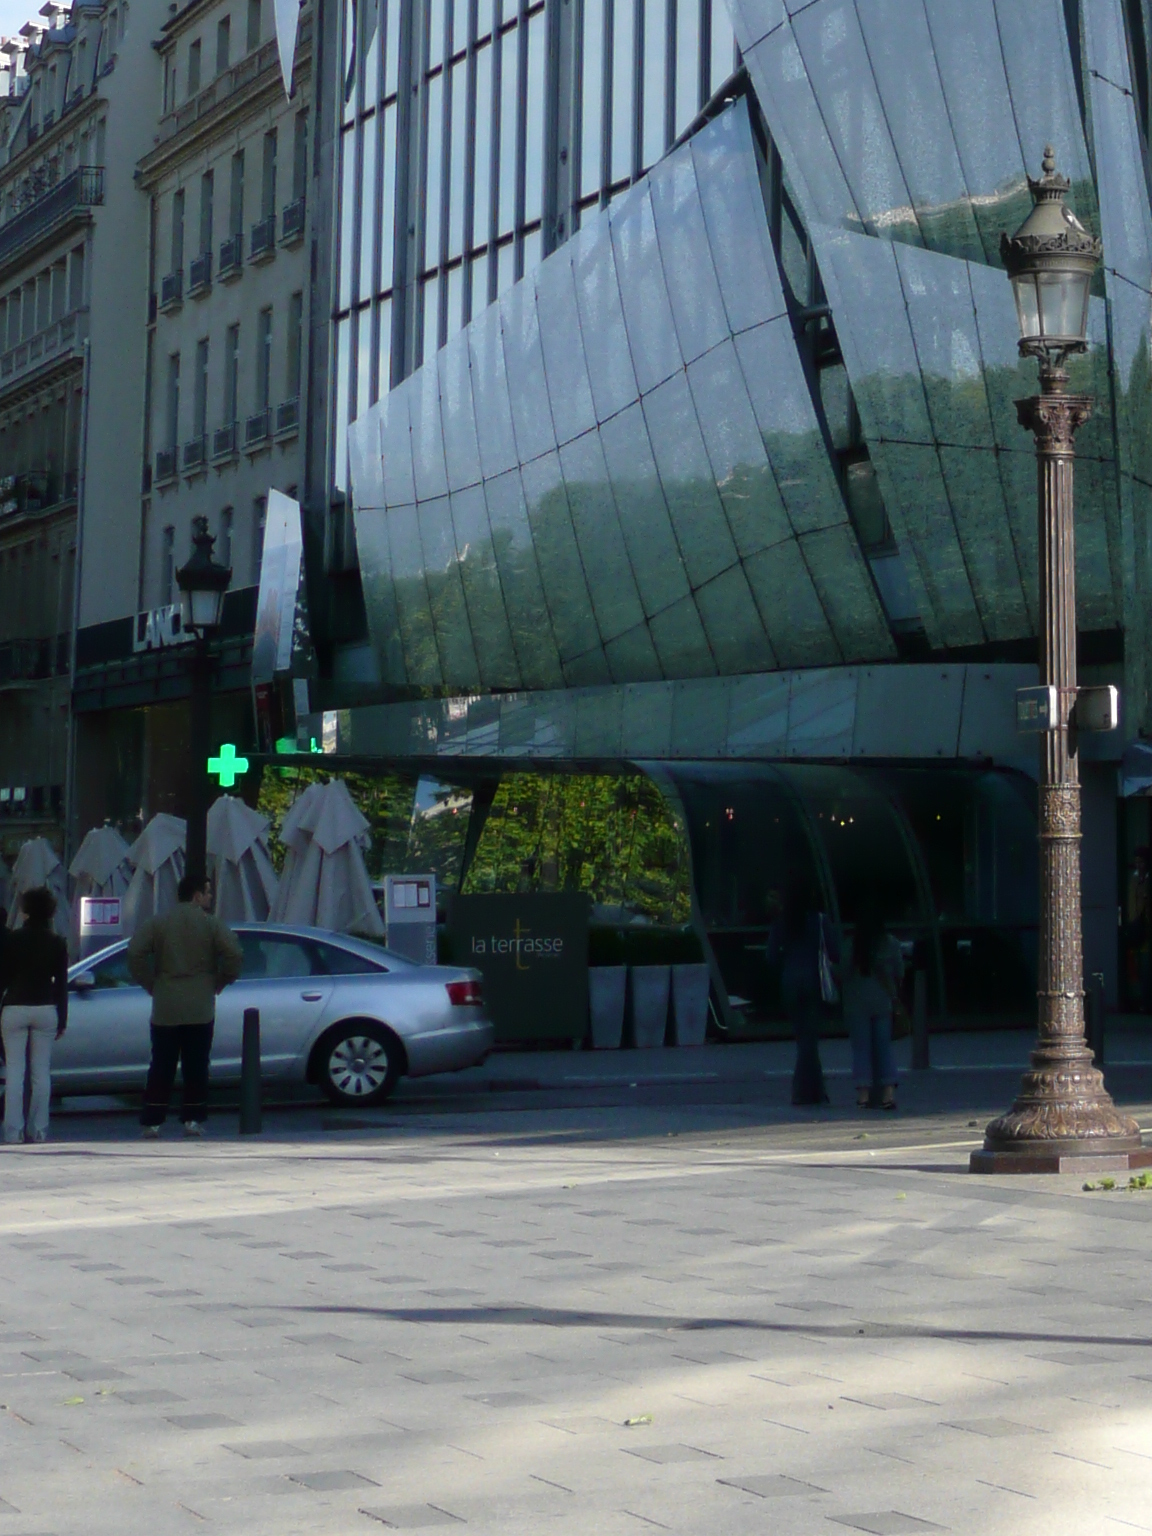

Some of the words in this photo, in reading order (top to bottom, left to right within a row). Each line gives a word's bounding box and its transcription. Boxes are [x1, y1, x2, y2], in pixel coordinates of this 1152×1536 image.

[132, 604, 204, 653] LANC
[471, 936, 486, 953] la
[491, 936, 564, 953] terrasse
